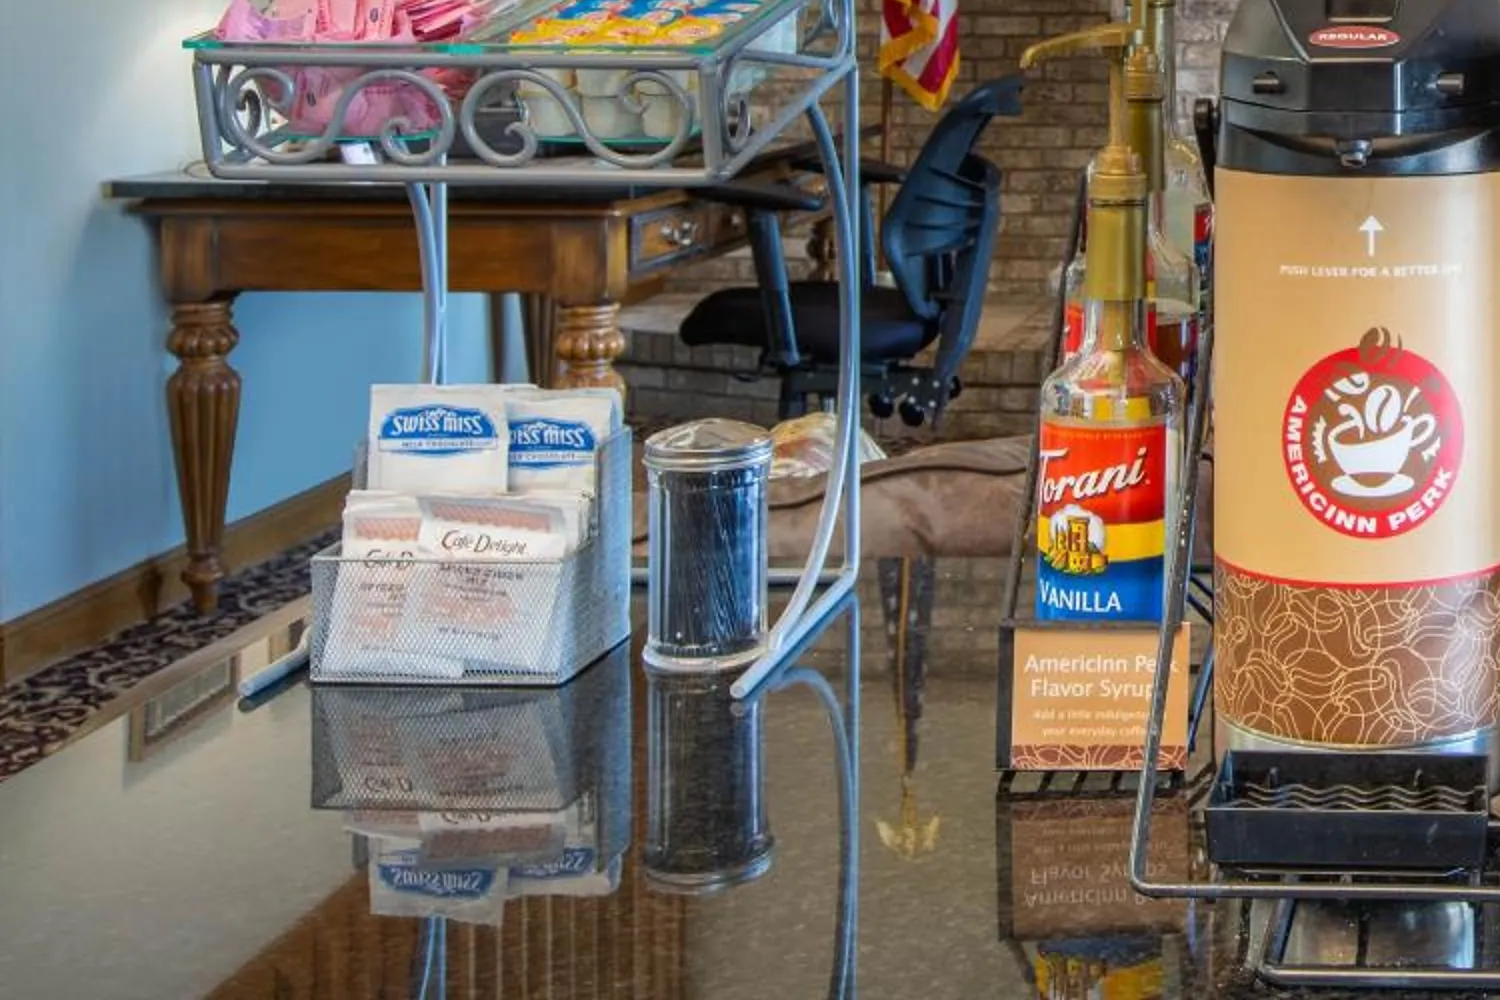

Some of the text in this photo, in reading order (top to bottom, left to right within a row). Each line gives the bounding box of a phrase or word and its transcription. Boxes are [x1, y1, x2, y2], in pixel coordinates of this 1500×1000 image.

[1318, 32, 1388, 42] REGULAR
[1380, 267, 1390, 277] A
[1286, 394, 1453, 534] AMERICINN PERK
[1039, 446, 1147, 510] Torani
[474, 533, 528, 556] Delight
[1040, 577, 1123, 613] VANILLA
[1024, 653, 1179, 674] AmericInn Pek
[1030, 675, 1154, 703] Flavor Syrup
